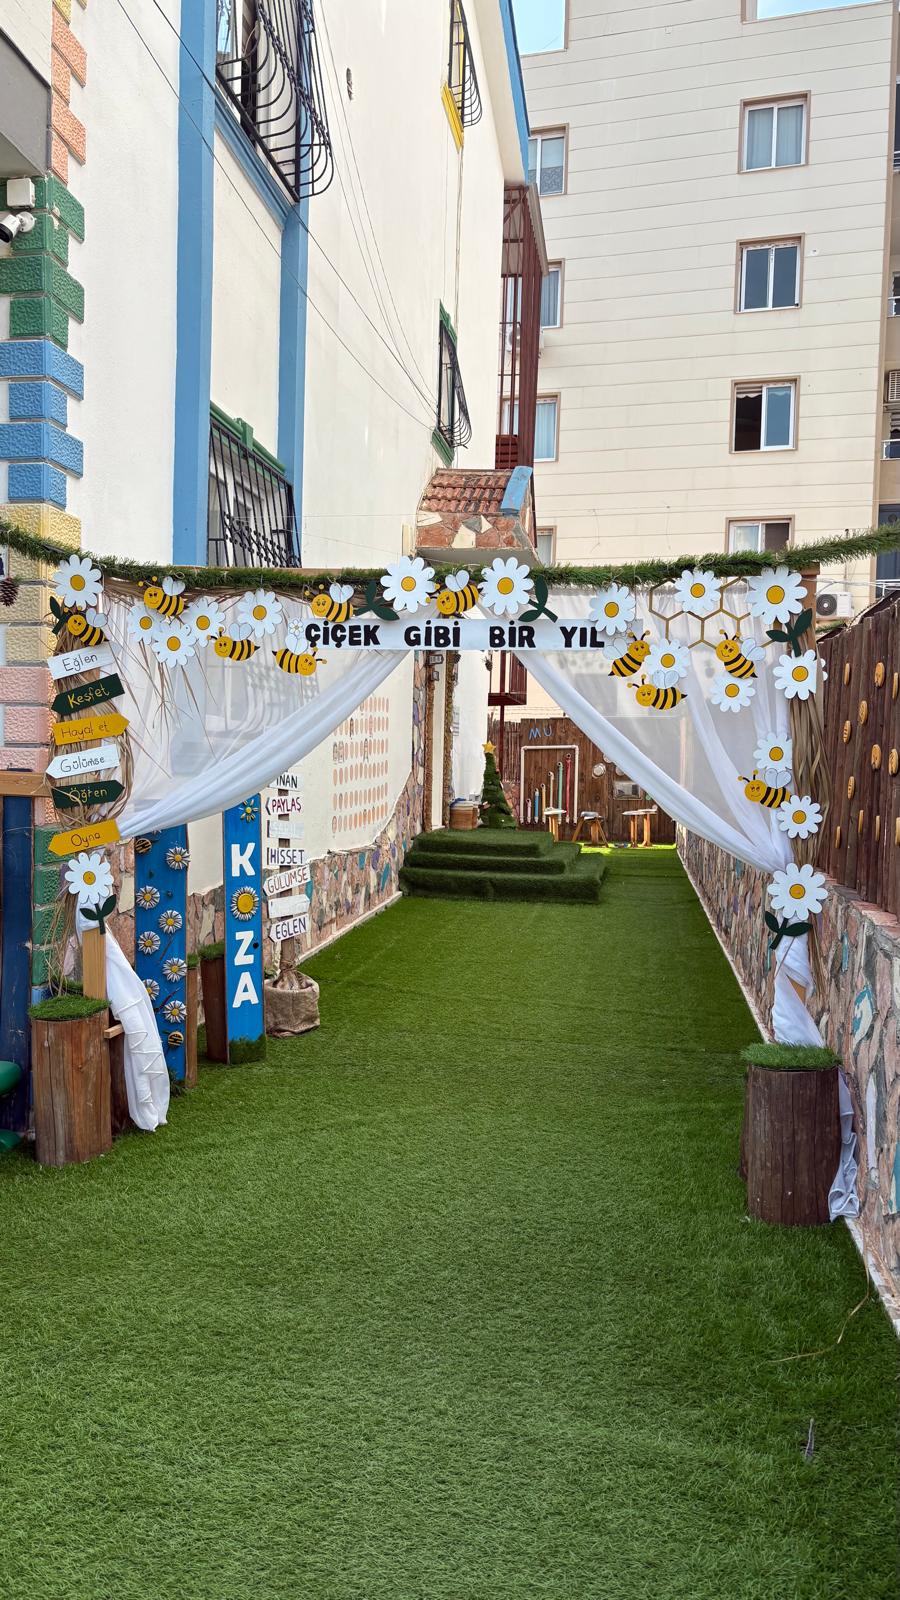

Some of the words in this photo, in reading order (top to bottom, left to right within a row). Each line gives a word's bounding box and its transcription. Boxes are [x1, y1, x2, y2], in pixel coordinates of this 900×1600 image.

[305, 620, 381, 647] ÇİÇEK
[404, 620, 461, 648] GİBİ
[489, 619, 537, 648] BİR
[561, 626, 605, 648] YIL
[62, 653, 98, 672] Eğlen
[61, 721, 94, 740] Hayal
[98, 720, 109, 732] et
[60, 756, 105, 773] Gülümse
[271, 796, 302, 814] PAYLAŞ
[70, 832, 101, 848] Oyna
[270, 848, 305, 865] HİSSET
[267, 865, 309, 894] GÜLÜMSE
[275, 917, 307, 940] EĞLEN
